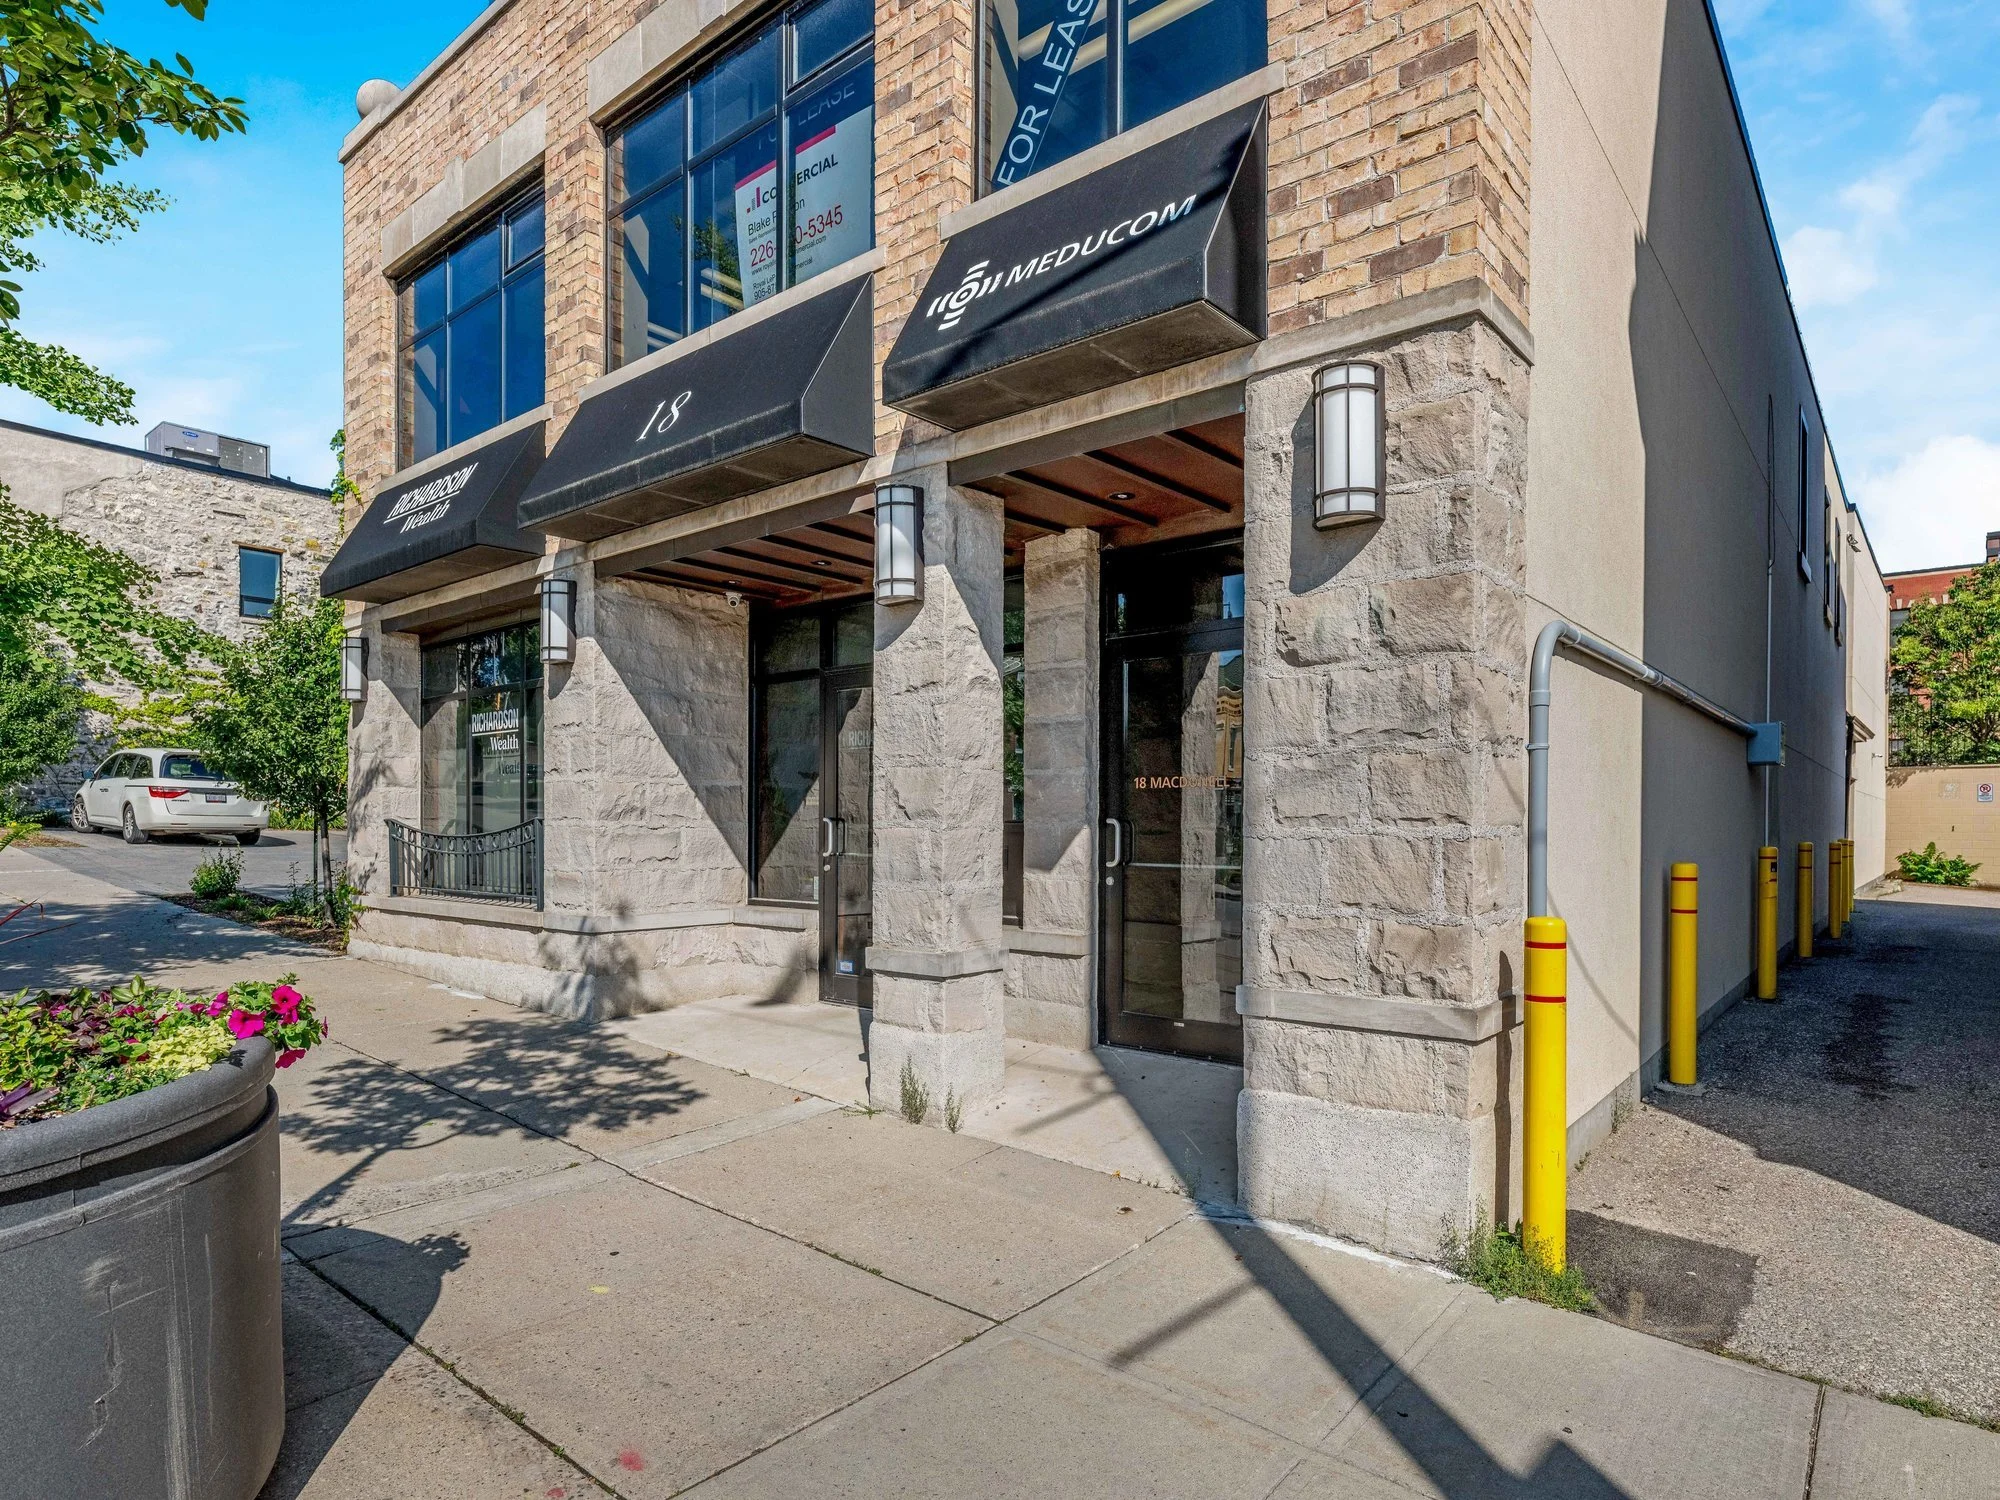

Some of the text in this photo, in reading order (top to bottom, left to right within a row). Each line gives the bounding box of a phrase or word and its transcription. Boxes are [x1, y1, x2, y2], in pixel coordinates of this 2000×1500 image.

[997, 0, 1094, 186] FOR LEAS
[762, 153, 839, 204] COERCIAL
[748, 216, 771, 236] Blake
[1004, 194, 1197, 288] MEDUCOM
[754, 284, 776, 300] 905-87
[635, 390, 692, 443] 18
[386, 462, 479, 520] RICHARDSON
[400, 499, 450, 534] Wealth
[472, 708, 519, 733] RICHARDSON
[490, 734, 519, 751] Wealth
[1133, 775, 1230, 789] 18 MACDONELL
